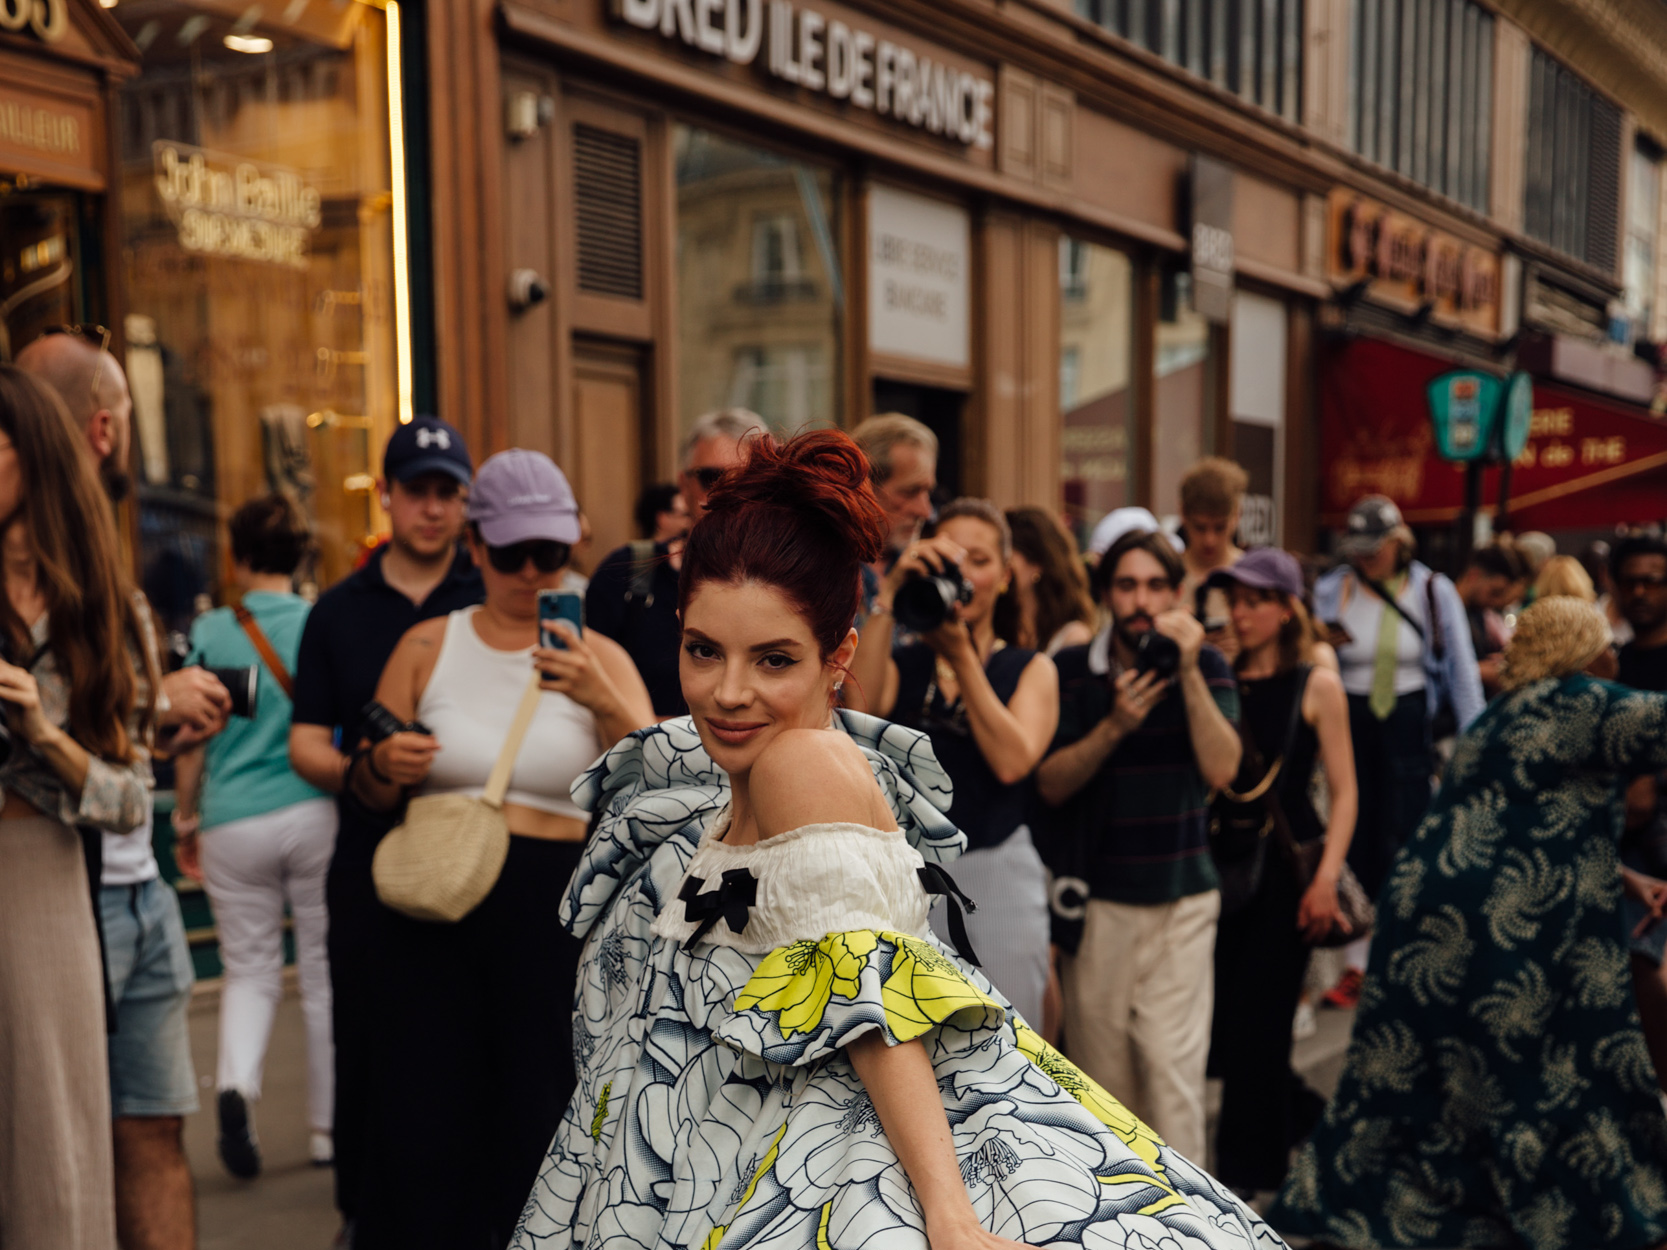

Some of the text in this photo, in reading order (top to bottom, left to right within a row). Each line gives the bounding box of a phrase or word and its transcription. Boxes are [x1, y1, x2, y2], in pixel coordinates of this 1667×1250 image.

[768, 0, 826, 91] ILE
[827, 19, 877, 108] DE
[876, 40, 994, 149] FRANCE
